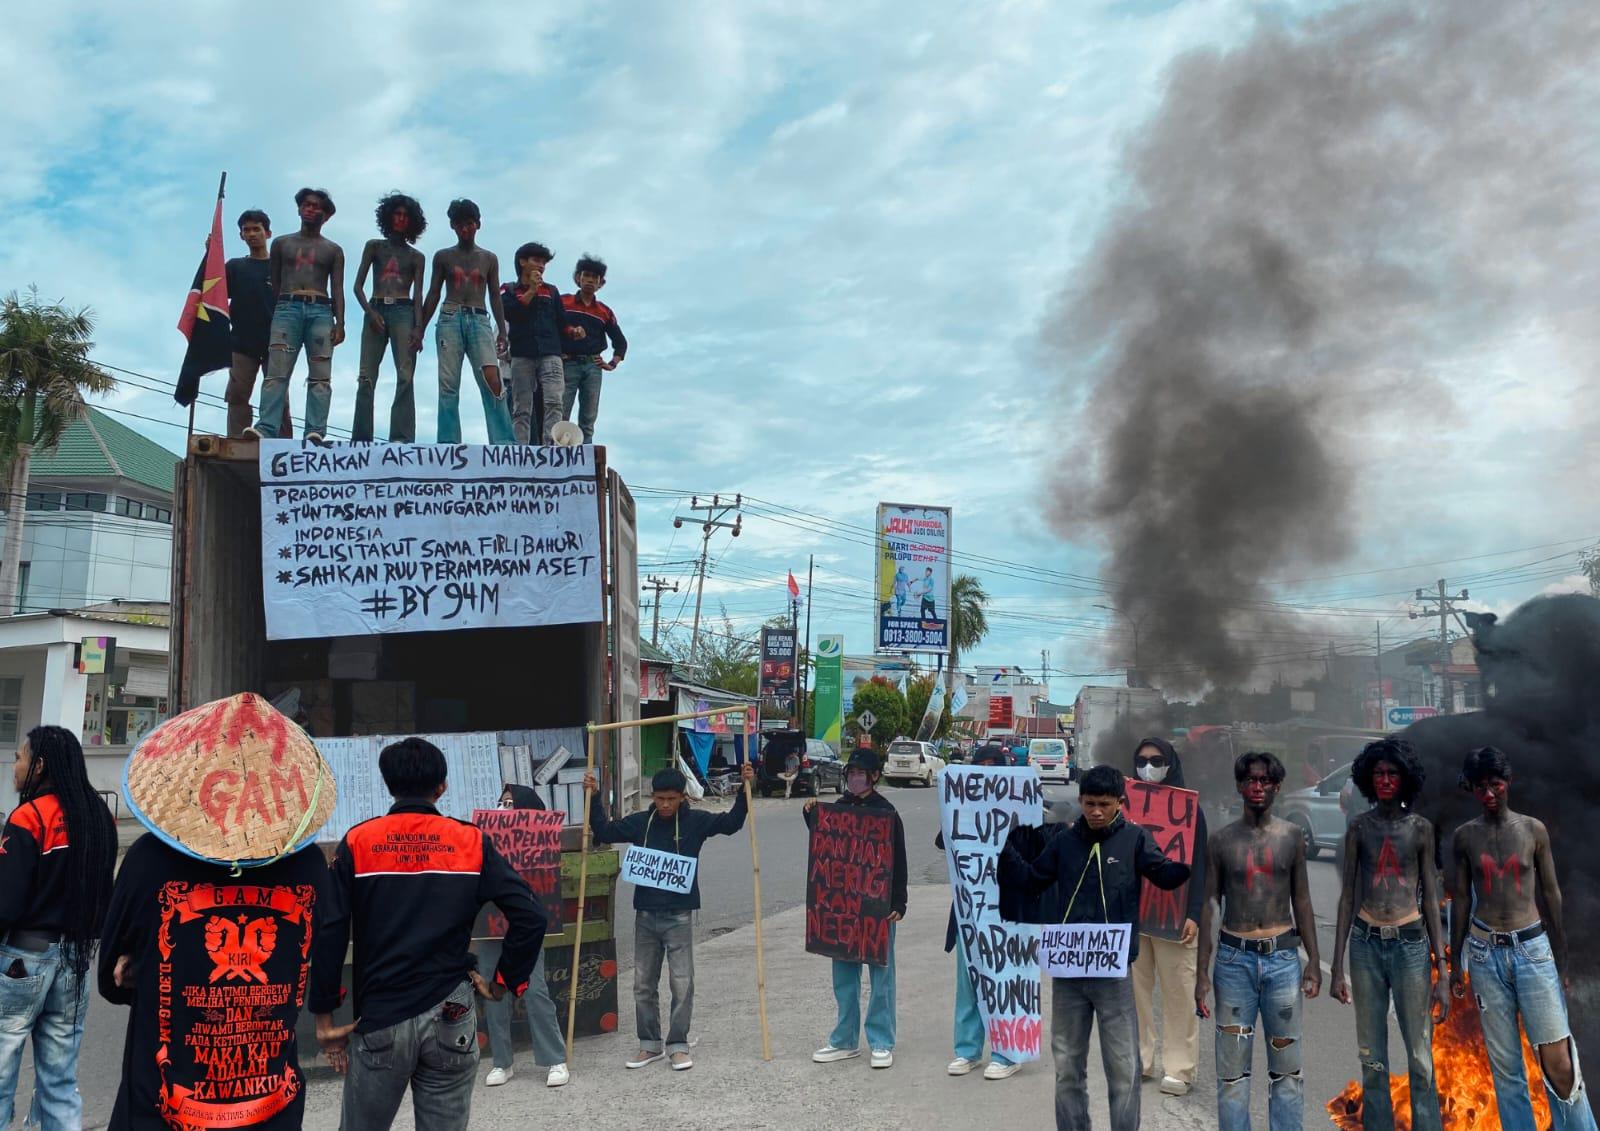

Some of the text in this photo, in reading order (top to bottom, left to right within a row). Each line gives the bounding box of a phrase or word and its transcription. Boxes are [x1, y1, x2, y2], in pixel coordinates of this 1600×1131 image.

[271, 450, 371, 477] GERAKAN
[382, 445, 468, 471] AKTIVIS
[273, 485, 357, 504] PRABOWO
[364, 483, 454, 500] PELANGGAR
[462, 484, 504, 500] HAM
[290, 499, 559, 523] TUNTASKAN PELANGGARAN HAM DI
[295, 526, 383, 542] INDONESIA
[926, 528, 945, 537] ONLINE
[884, 551, 912, 561] PALOPO
[888, 541, 909, 551] MARI
[293, 555, 596, 588] SAHKAN RUU PERAMPASAN ASET
[361, 585, 438, 619] #BY
[198, 763, 309, 836] GAM
[944, 772, 1043, 805] MENOLAK
[477, 811, 566, 829] HUKUM MATI
[511, 829, 560, 848] PELAKU
[812, 831, 847, 858] DAN
[626, 849, 691, 876] HUKUM MATI
[1372, 835, 1407, 890] A
[1479, 851, 1522, 897] M
[629, 863, 687, 888] KORUPTOR
[815, 883, 862, 915] KAN
[808, 909, 889, 961] NEGARA
[1041, 929, 1125, 951] HUKUM MATI
[229, 952, 252, 966] KIRI
[1047, 950, 1121, 974] KORUPTOR
[182, 985, 206, 997] JIKA
[209, 985, 247, 997] HATIMU
[187, 994, 288, 1008] MELIHAT PENINDASAN
[226, 1007, 253, 1022] DAN
[185, 1030, 288, 1047] PADA KETIDAKADILAN
[192, 1020, 283, 1035] JIWAMU BERONTAK
[194, 1042, 280, 1064] MAKA KAU
[205, 1058, 267, 1081] ADALAH
[194, 1075, 279, 1100] KAWANKU
